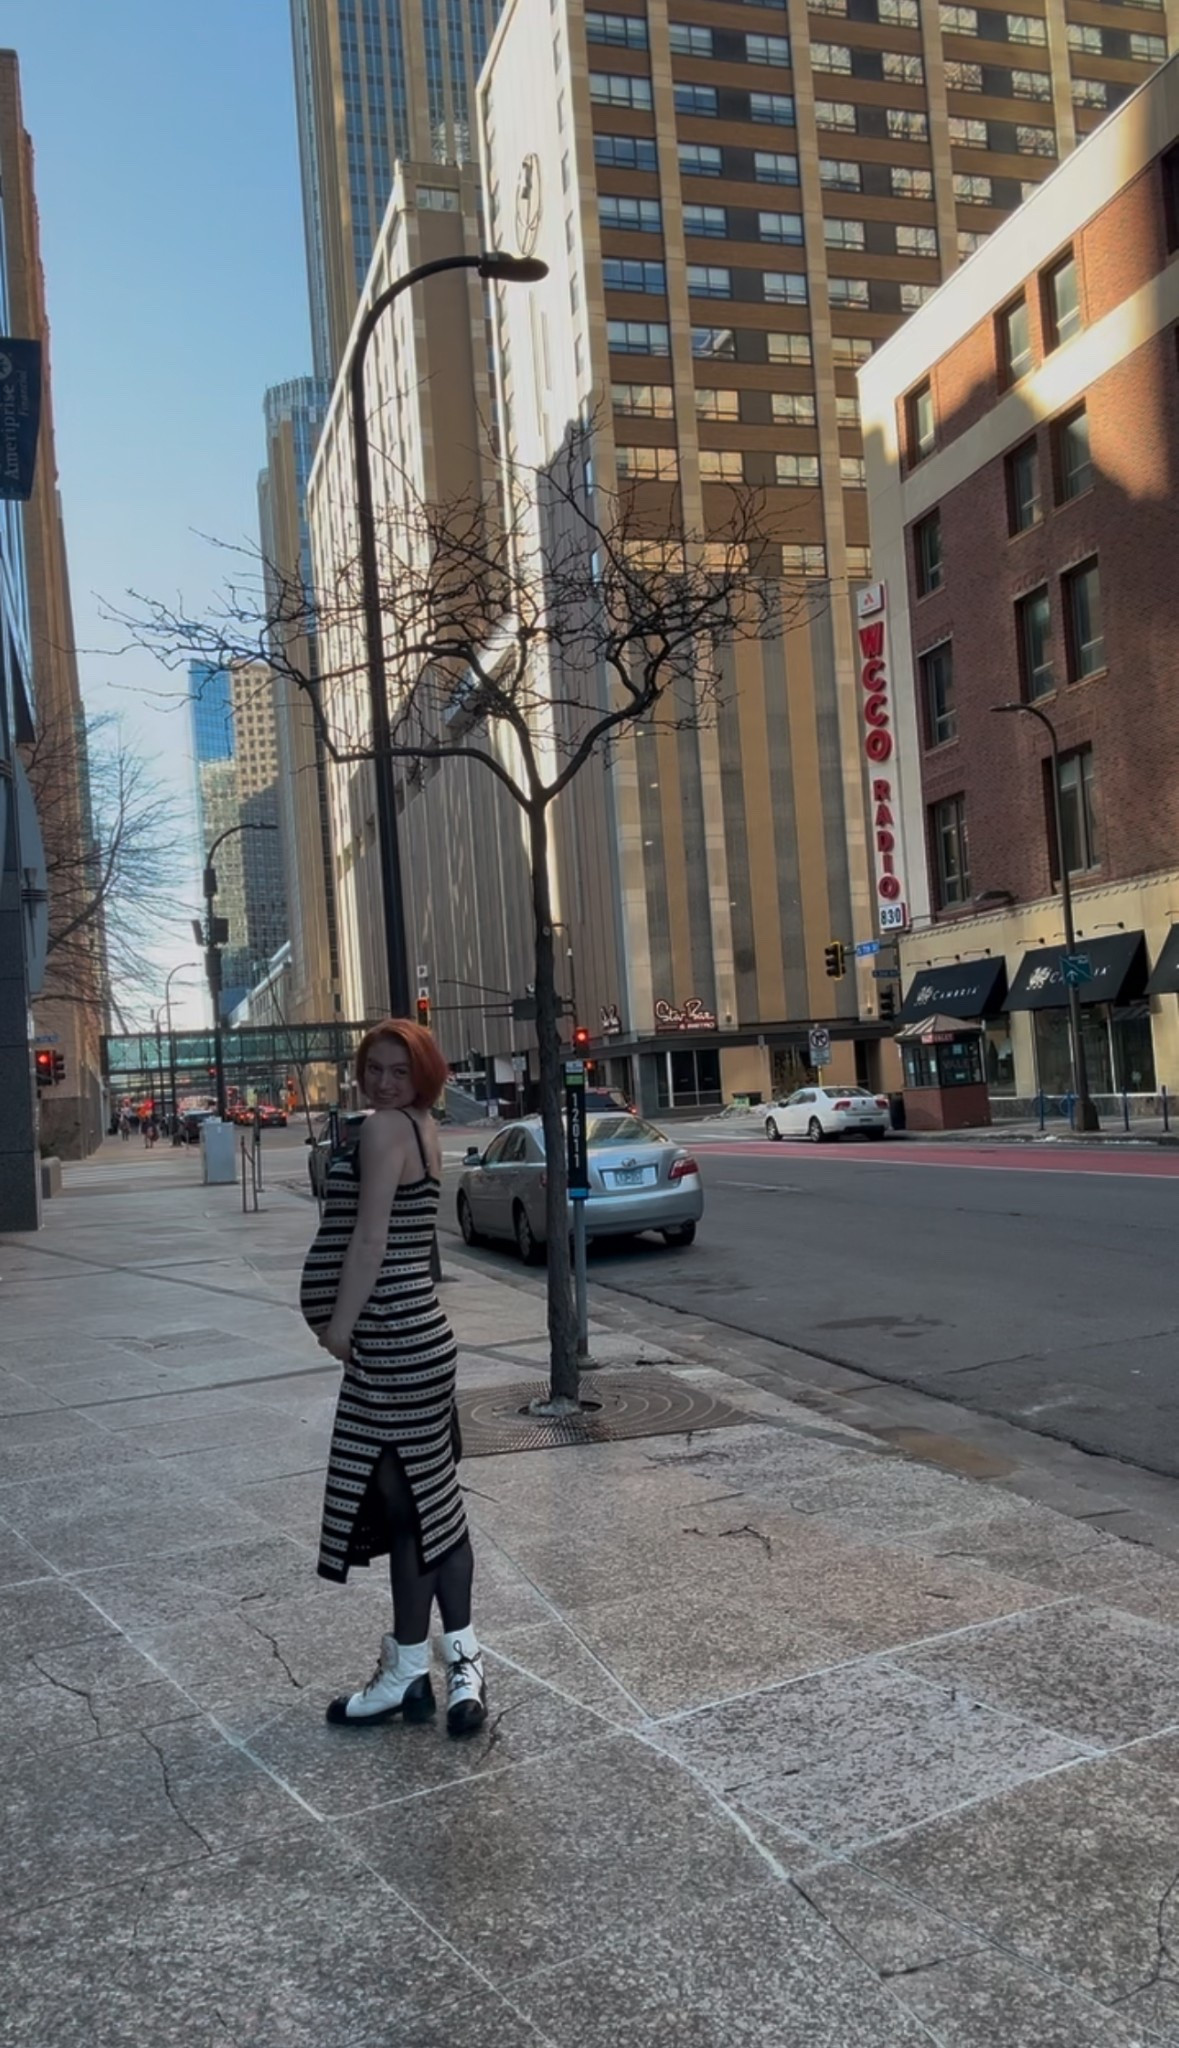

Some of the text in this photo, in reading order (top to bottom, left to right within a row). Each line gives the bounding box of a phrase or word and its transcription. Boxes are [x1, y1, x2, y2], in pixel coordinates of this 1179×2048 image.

[1, 384, 20, 480] Ameriprise
[859, 621, 892, 762] WCCO
[873, 779, 900, 900] RADIO
[880, 907, 902, 925] 830
[571, 1093, 580, 1168] 12011
